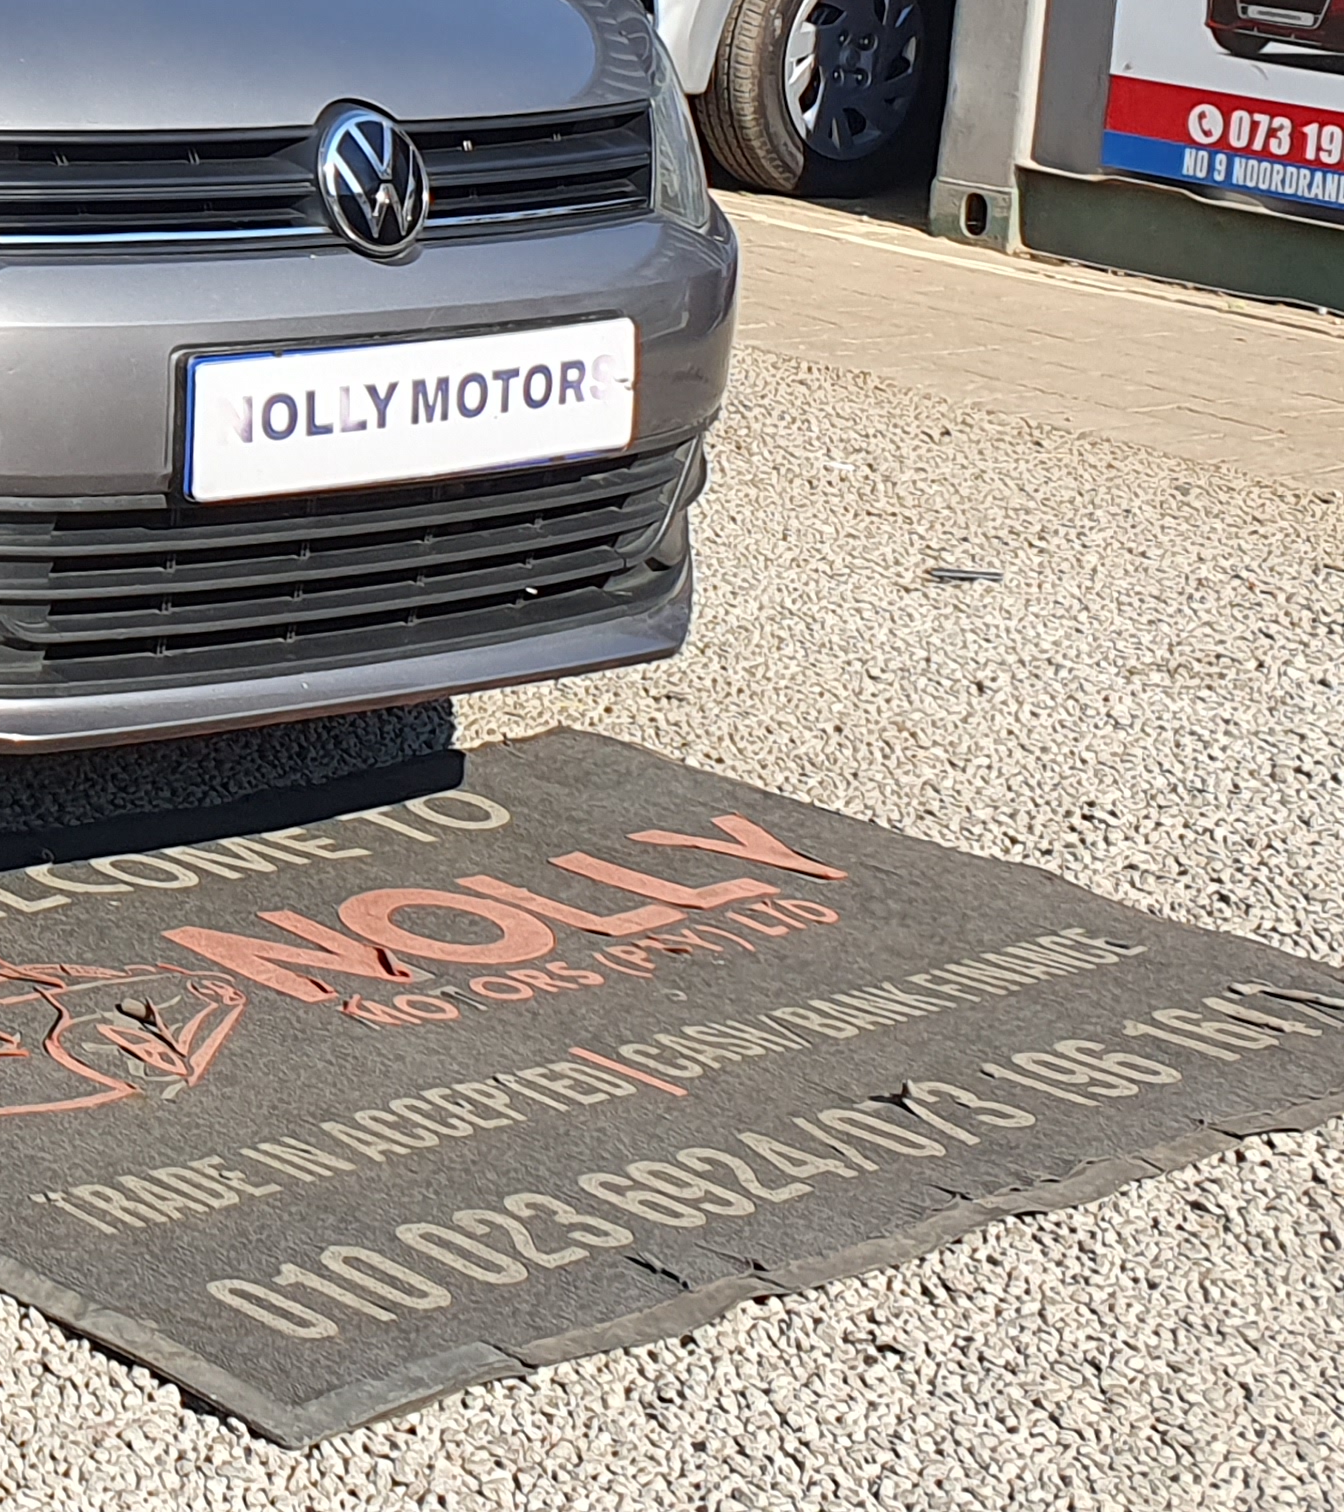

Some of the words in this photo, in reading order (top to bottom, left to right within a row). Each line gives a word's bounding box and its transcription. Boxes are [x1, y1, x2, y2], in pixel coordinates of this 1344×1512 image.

[1182, 148, 1209, 179] NO
[1213, 153, 1228, 182] 9
[1229, 109, 1293, 156] 073
[335, 790, 511, 843] TO
[161, 812, 849, 1002] NOLLY
[28, 1155, 284, 1235] TRADE
[239, 1136, 357, 1182] IN
[320, 1060, 638, 1164] ACCEPTED
[618, 981, 958, 1079] CASH/BANK
[904, 927, 1148, 1003] FINANCE
[207, 1245, 452, 1340] 010
[395, 1193, 635, 1285] 023
[577, 1079, 1037, 1228] 6924/073
[980, 1039, 1182, 1107] 196
